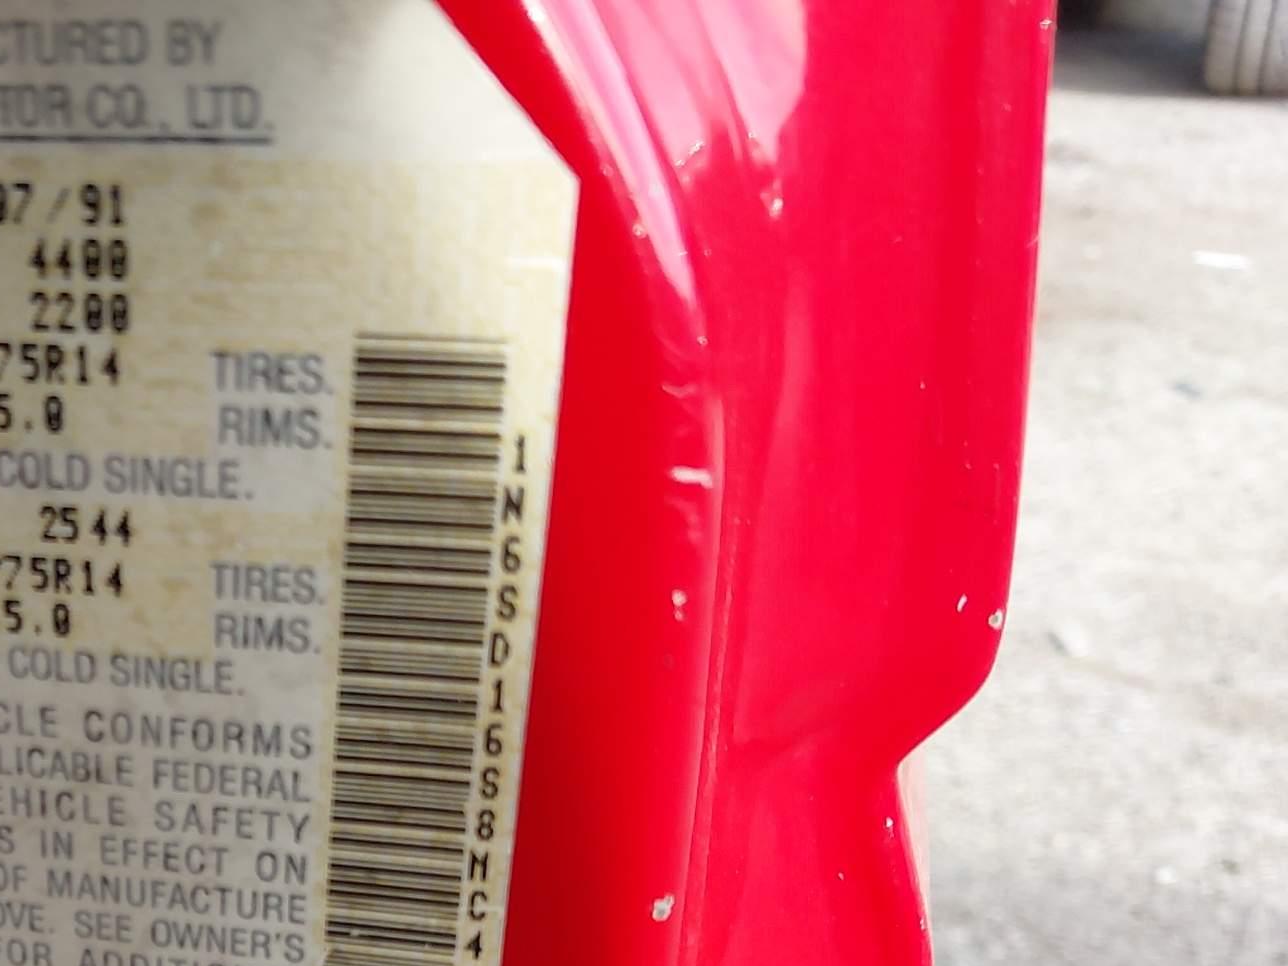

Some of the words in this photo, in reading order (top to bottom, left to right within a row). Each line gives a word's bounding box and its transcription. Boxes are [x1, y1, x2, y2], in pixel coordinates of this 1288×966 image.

[166, 22, 223, 66] BY
[187, 87, 274, 131] LTD.
[28, 240, 130, 280] 4400
[32, 292, 130, 333] 2200
[210, 351, 334, 395] TIRES.
[217, 405, 332, 450] RIMS.
[103, 456, 253, 499] SINGLE.
[39, 506, 133, 546] 2544
[210, 563, 325, 604] TIRES.
[214, 615, 320, 655] RIMS.
[7, 648, 96, 684] COLD
[109, 656, 245, 697] SINGLE.
[83, 710, 313, 761] CONFORMS
[152, 760, 310, 804] FEDERAL
[154, 802, 310, 845] SAFETY
[39, 828, 74, 862] IN
[100, 836, 230, 878] EFFECT
[256, 852, 307, 886] ON
[46, 868, 308, 926] MANUFACTURE
[74, 911, 133, 944] SEE
[150, 918, 306, 964] OWNER'S
